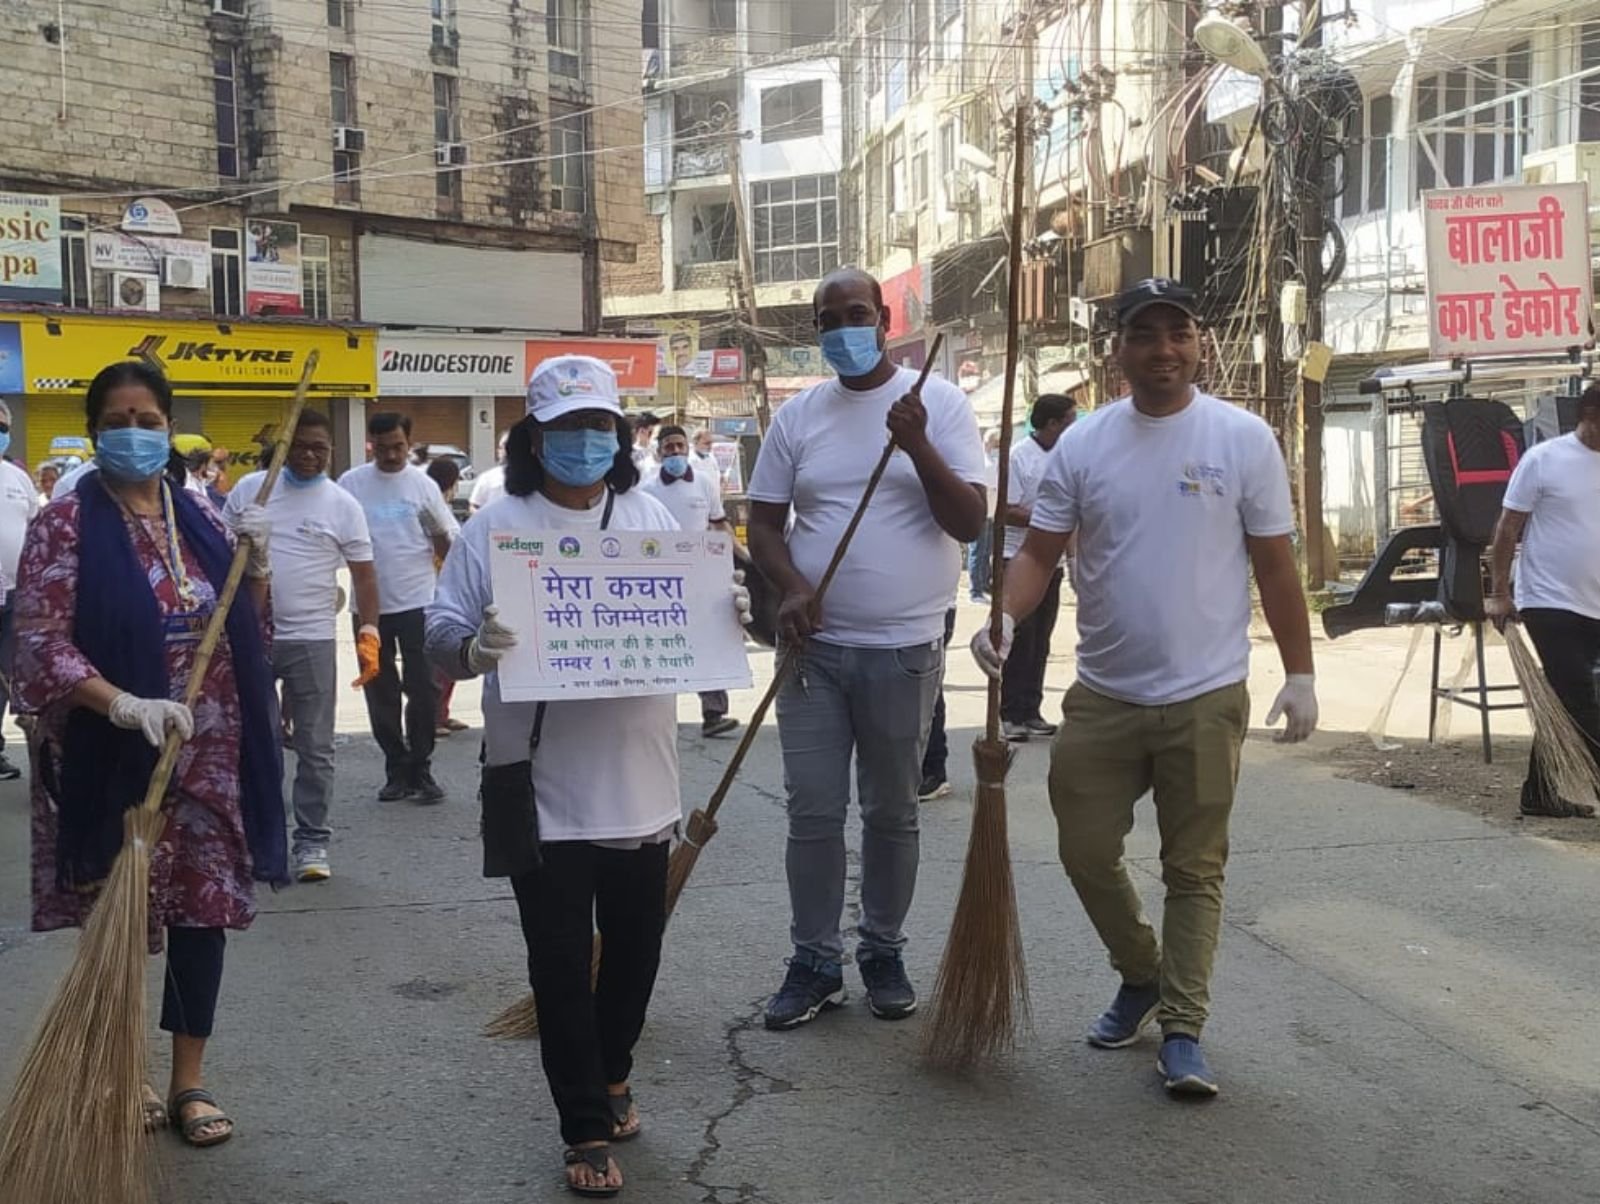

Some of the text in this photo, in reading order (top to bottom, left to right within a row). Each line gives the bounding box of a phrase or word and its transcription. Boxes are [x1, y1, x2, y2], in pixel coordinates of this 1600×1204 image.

[1445, 196, 1565, 264] बालाजी
[0, 254, 37, 281] pa
[1436, 273, 1581, 342] कार डेकोर
[382, 351, 514, 373] BRIDGESTONE
[541, 567, 684, 600] मेरा कचरा
[543, 602, 688, 628] मेरी जिम्मेदारी
[548, 638, 568, 651] अब
[575, 635, 614, 650] भोपाल
[622, 633, 639, 650] की
[644, 635, 654, 650] है
[603, 656, 611, 670] 1
[619, 654, 636, 669] की
[643, 655, 652, 669] है
[657, 653, 694, 668] तैयारी
